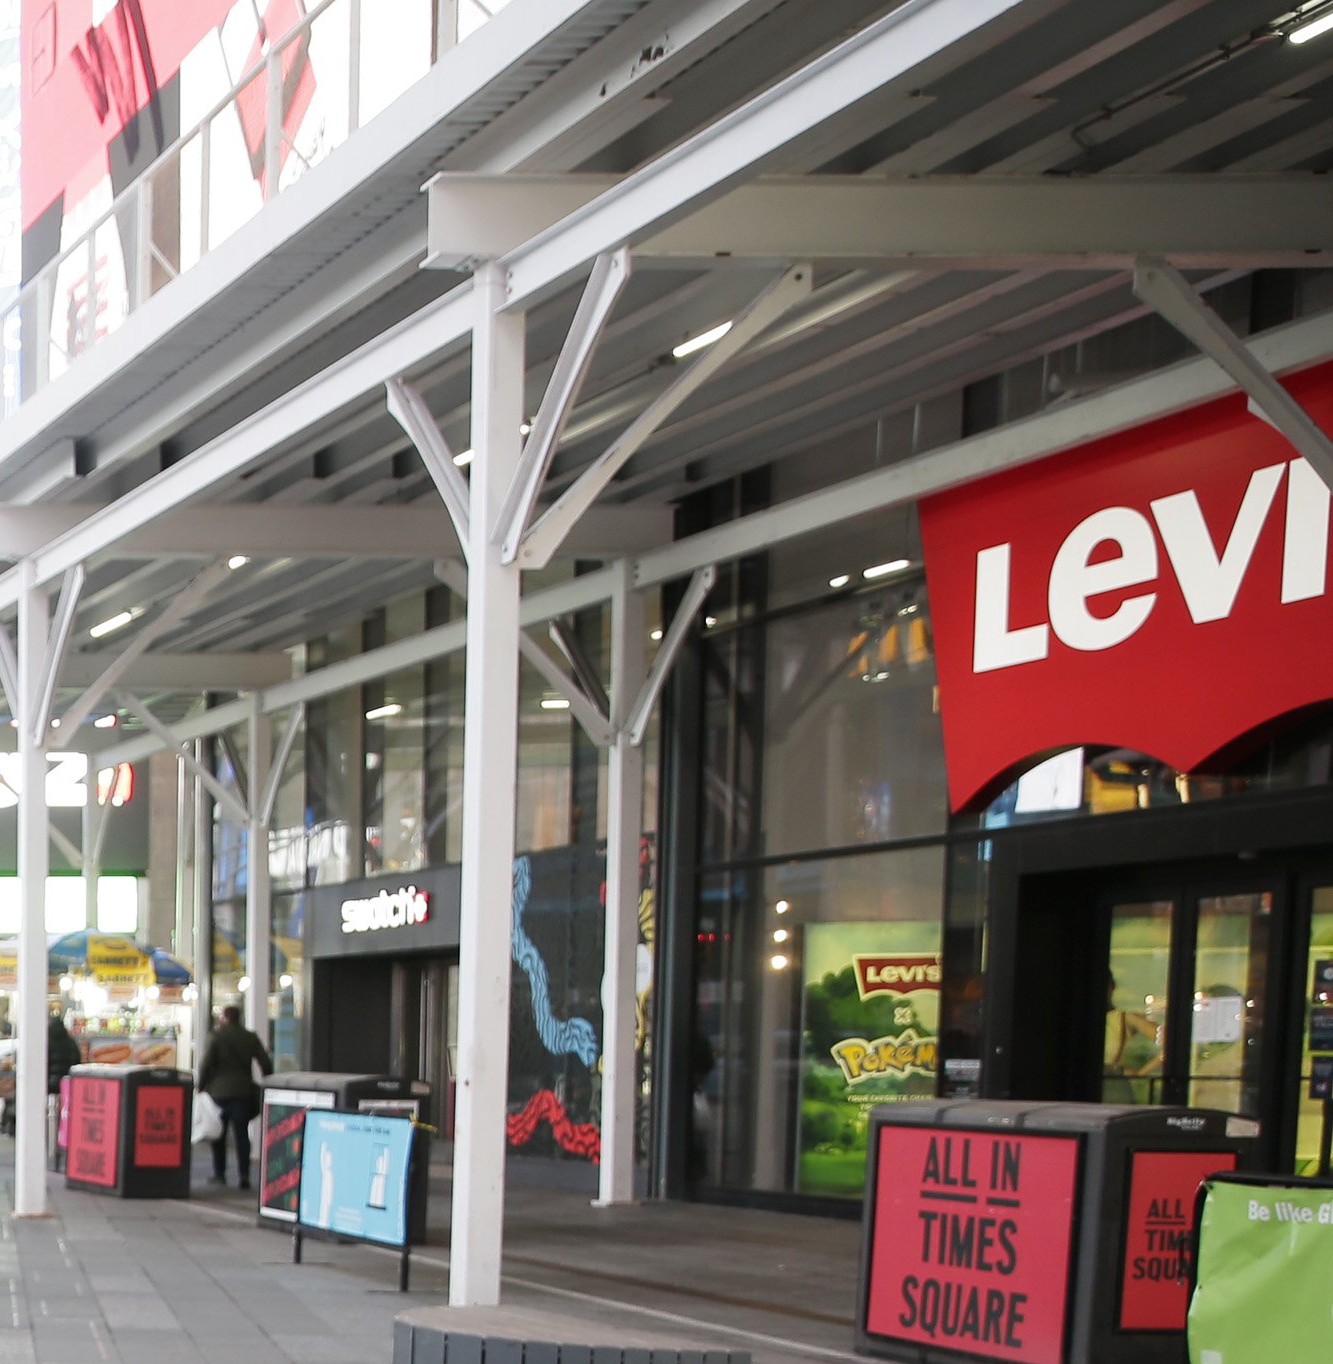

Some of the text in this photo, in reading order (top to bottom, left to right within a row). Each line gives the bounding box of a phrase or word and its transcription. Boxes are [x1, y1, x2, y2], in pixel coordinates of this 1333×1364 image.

[342, 886, 414, 933] swatch
[921, 1135, 1021, 1192] ALL IN
[1146, 1198, 1185, 1219] ALL
[1248, 1200, 1270, 1221] Be
[1275, 1202, 1313, 1223] like
[918, 1209, 1019, 1276] TIMES
[898, 1273, 1028, 1349] SQUARE
